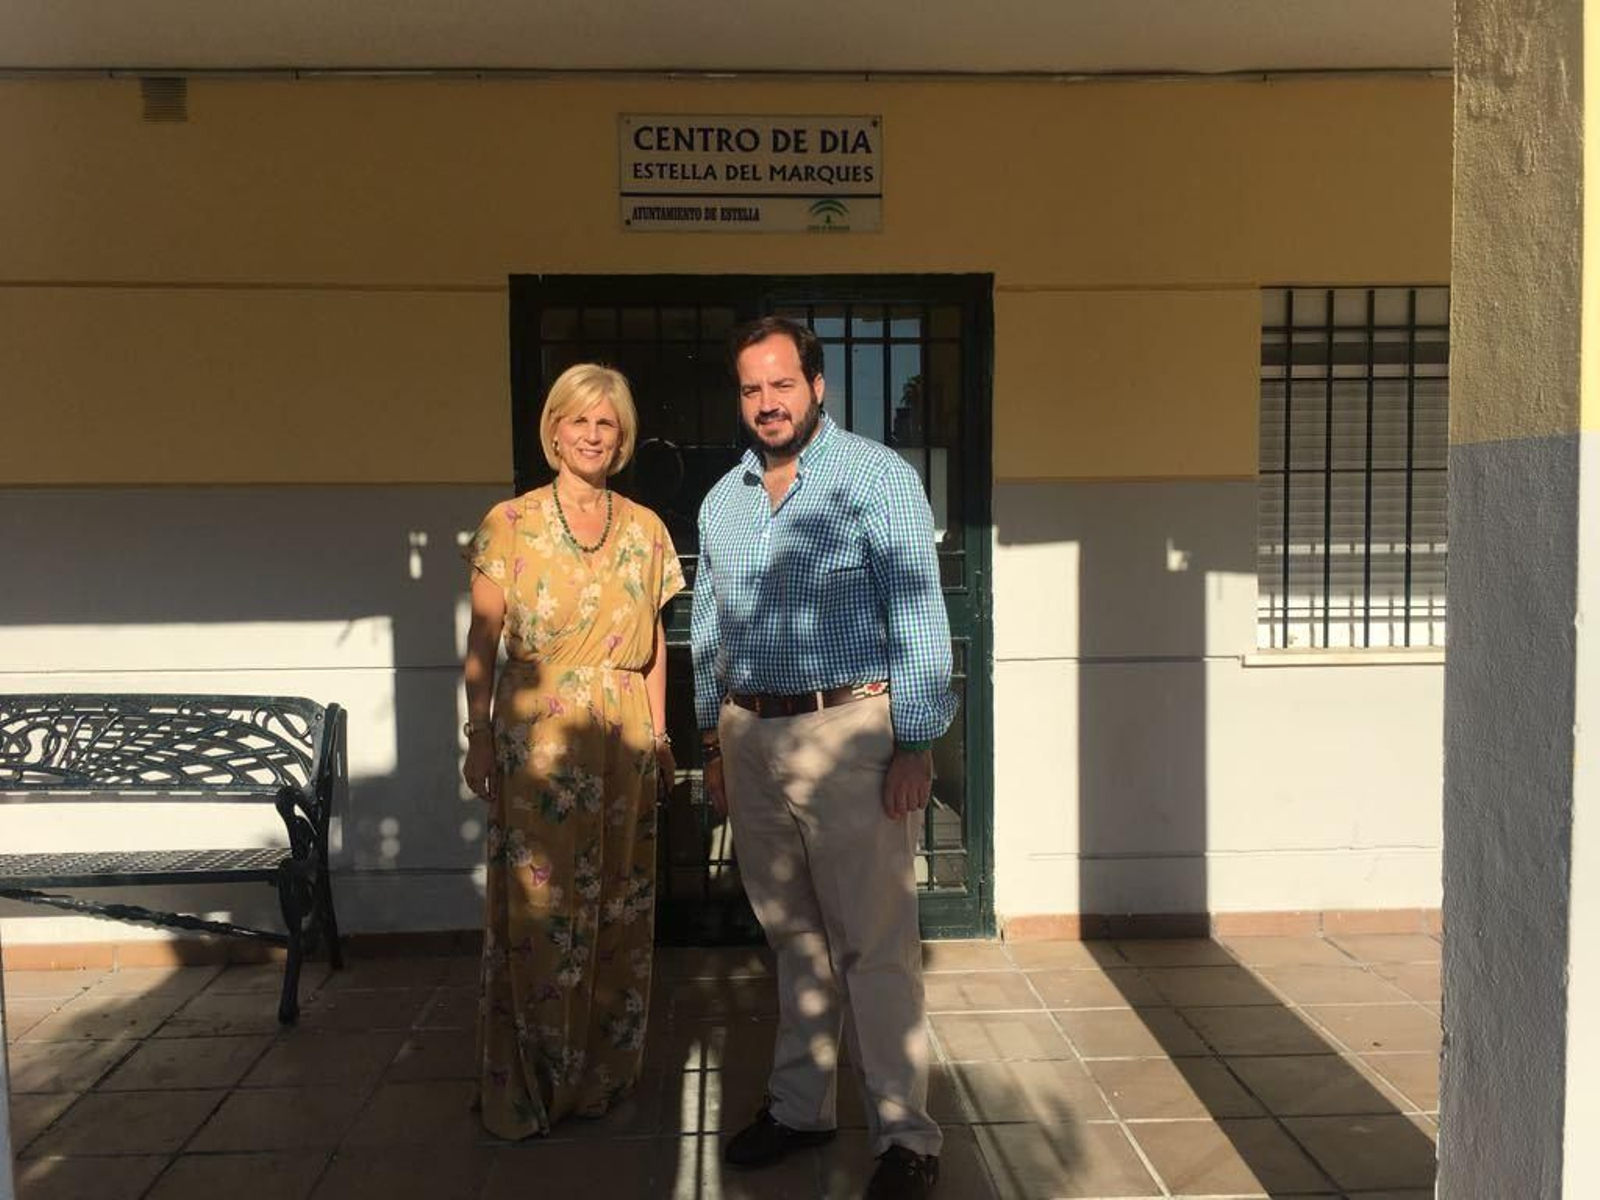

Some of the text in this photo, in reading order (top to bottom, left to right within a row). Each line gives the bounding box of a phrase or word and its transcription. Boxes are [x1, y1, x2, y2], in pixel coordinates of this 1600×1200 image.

[633, 126, 873, 154] CENTRO DE DIA
[632, 162, 874, 185] ESTELLA DEL MARQUES
[632, 207, 760, 222] AYUNTAMIENTO DE ESTELLA
